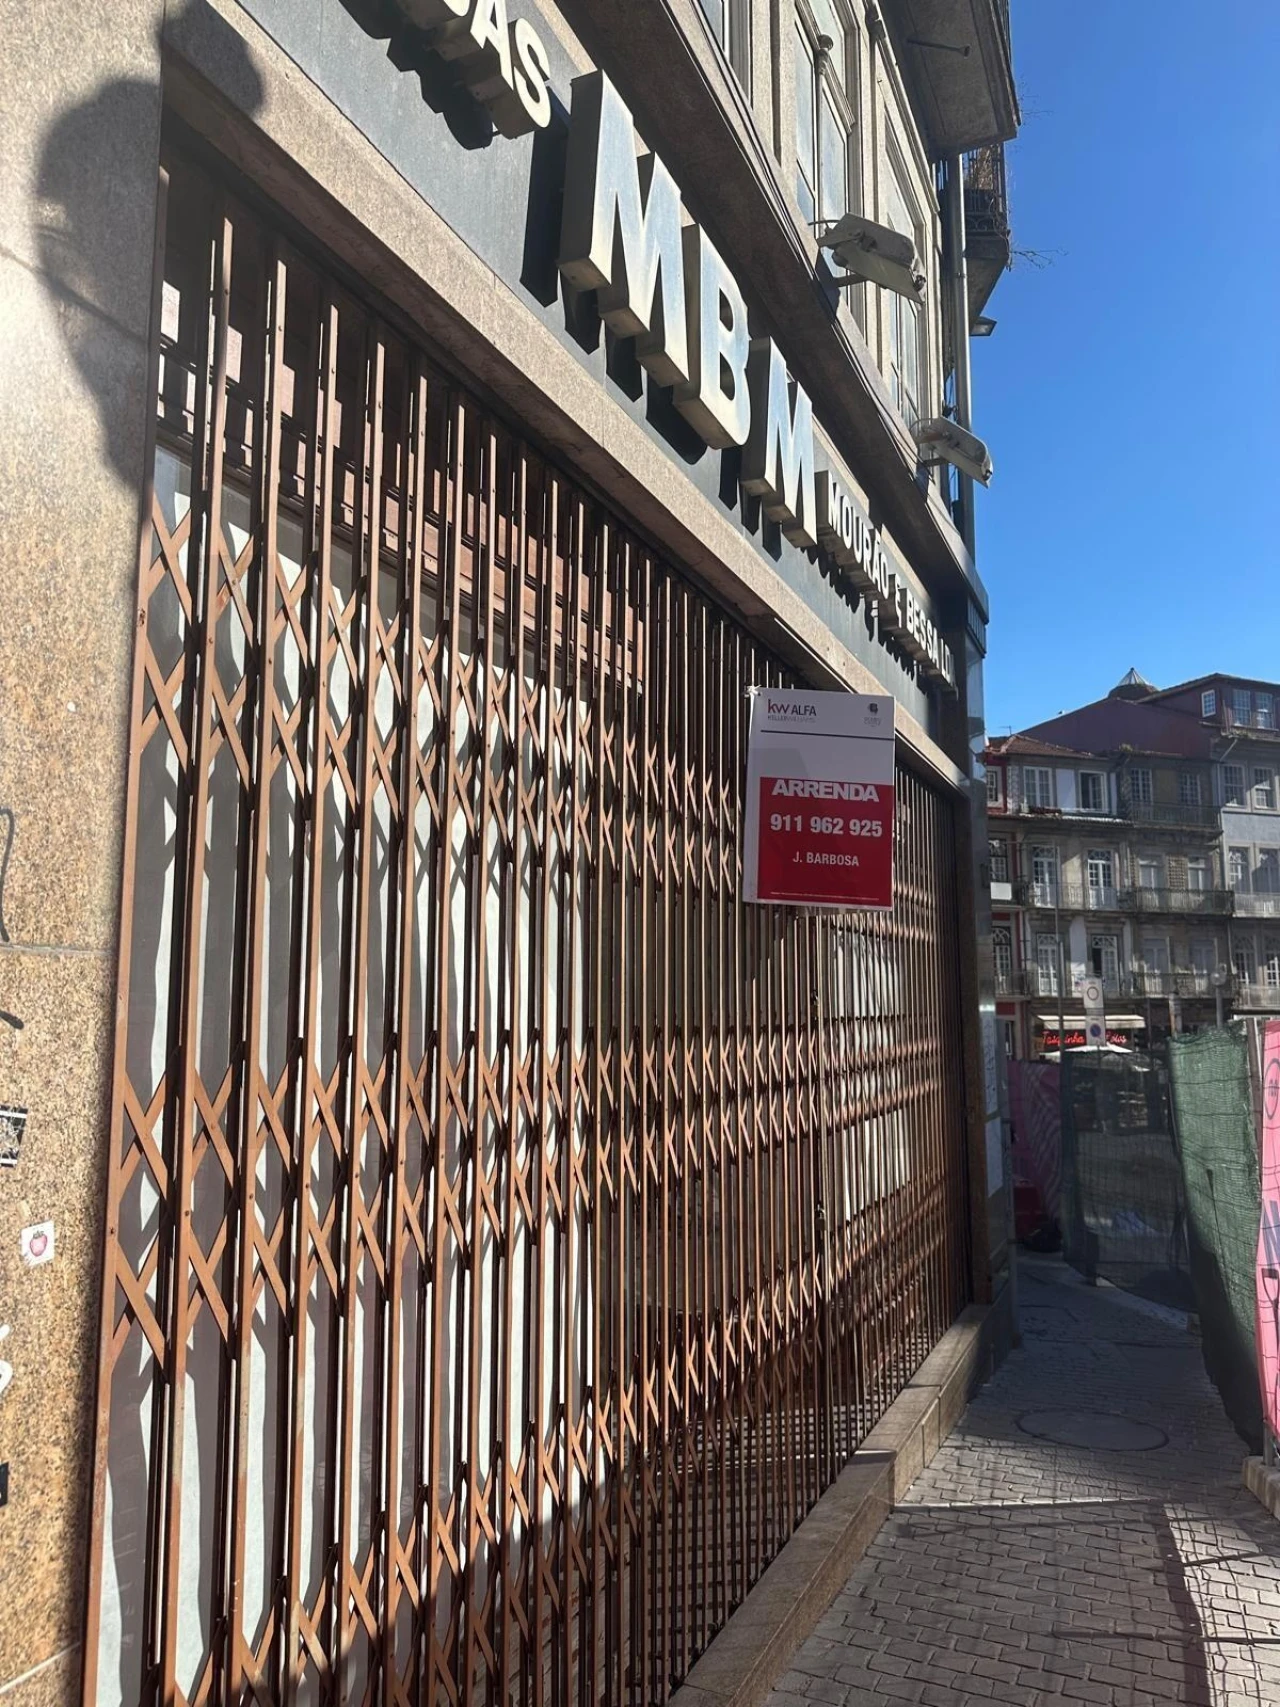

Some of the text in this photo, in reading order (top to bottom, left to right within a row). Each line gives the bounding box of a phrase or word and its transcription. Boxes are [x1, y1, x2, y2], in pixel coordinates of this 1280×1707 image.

[444, 0, 552, 128] AS
[827, 469, 890, 600] MOURÃO
[906, 587, 940, 670] BESSA
[791, 704, 817, 717] ALFA
[771, 778, 880, 802] ARRENDA
[770, 813, 883, 838] 911 962 925
[793, 852, 860, 868] J. BARBOSA
